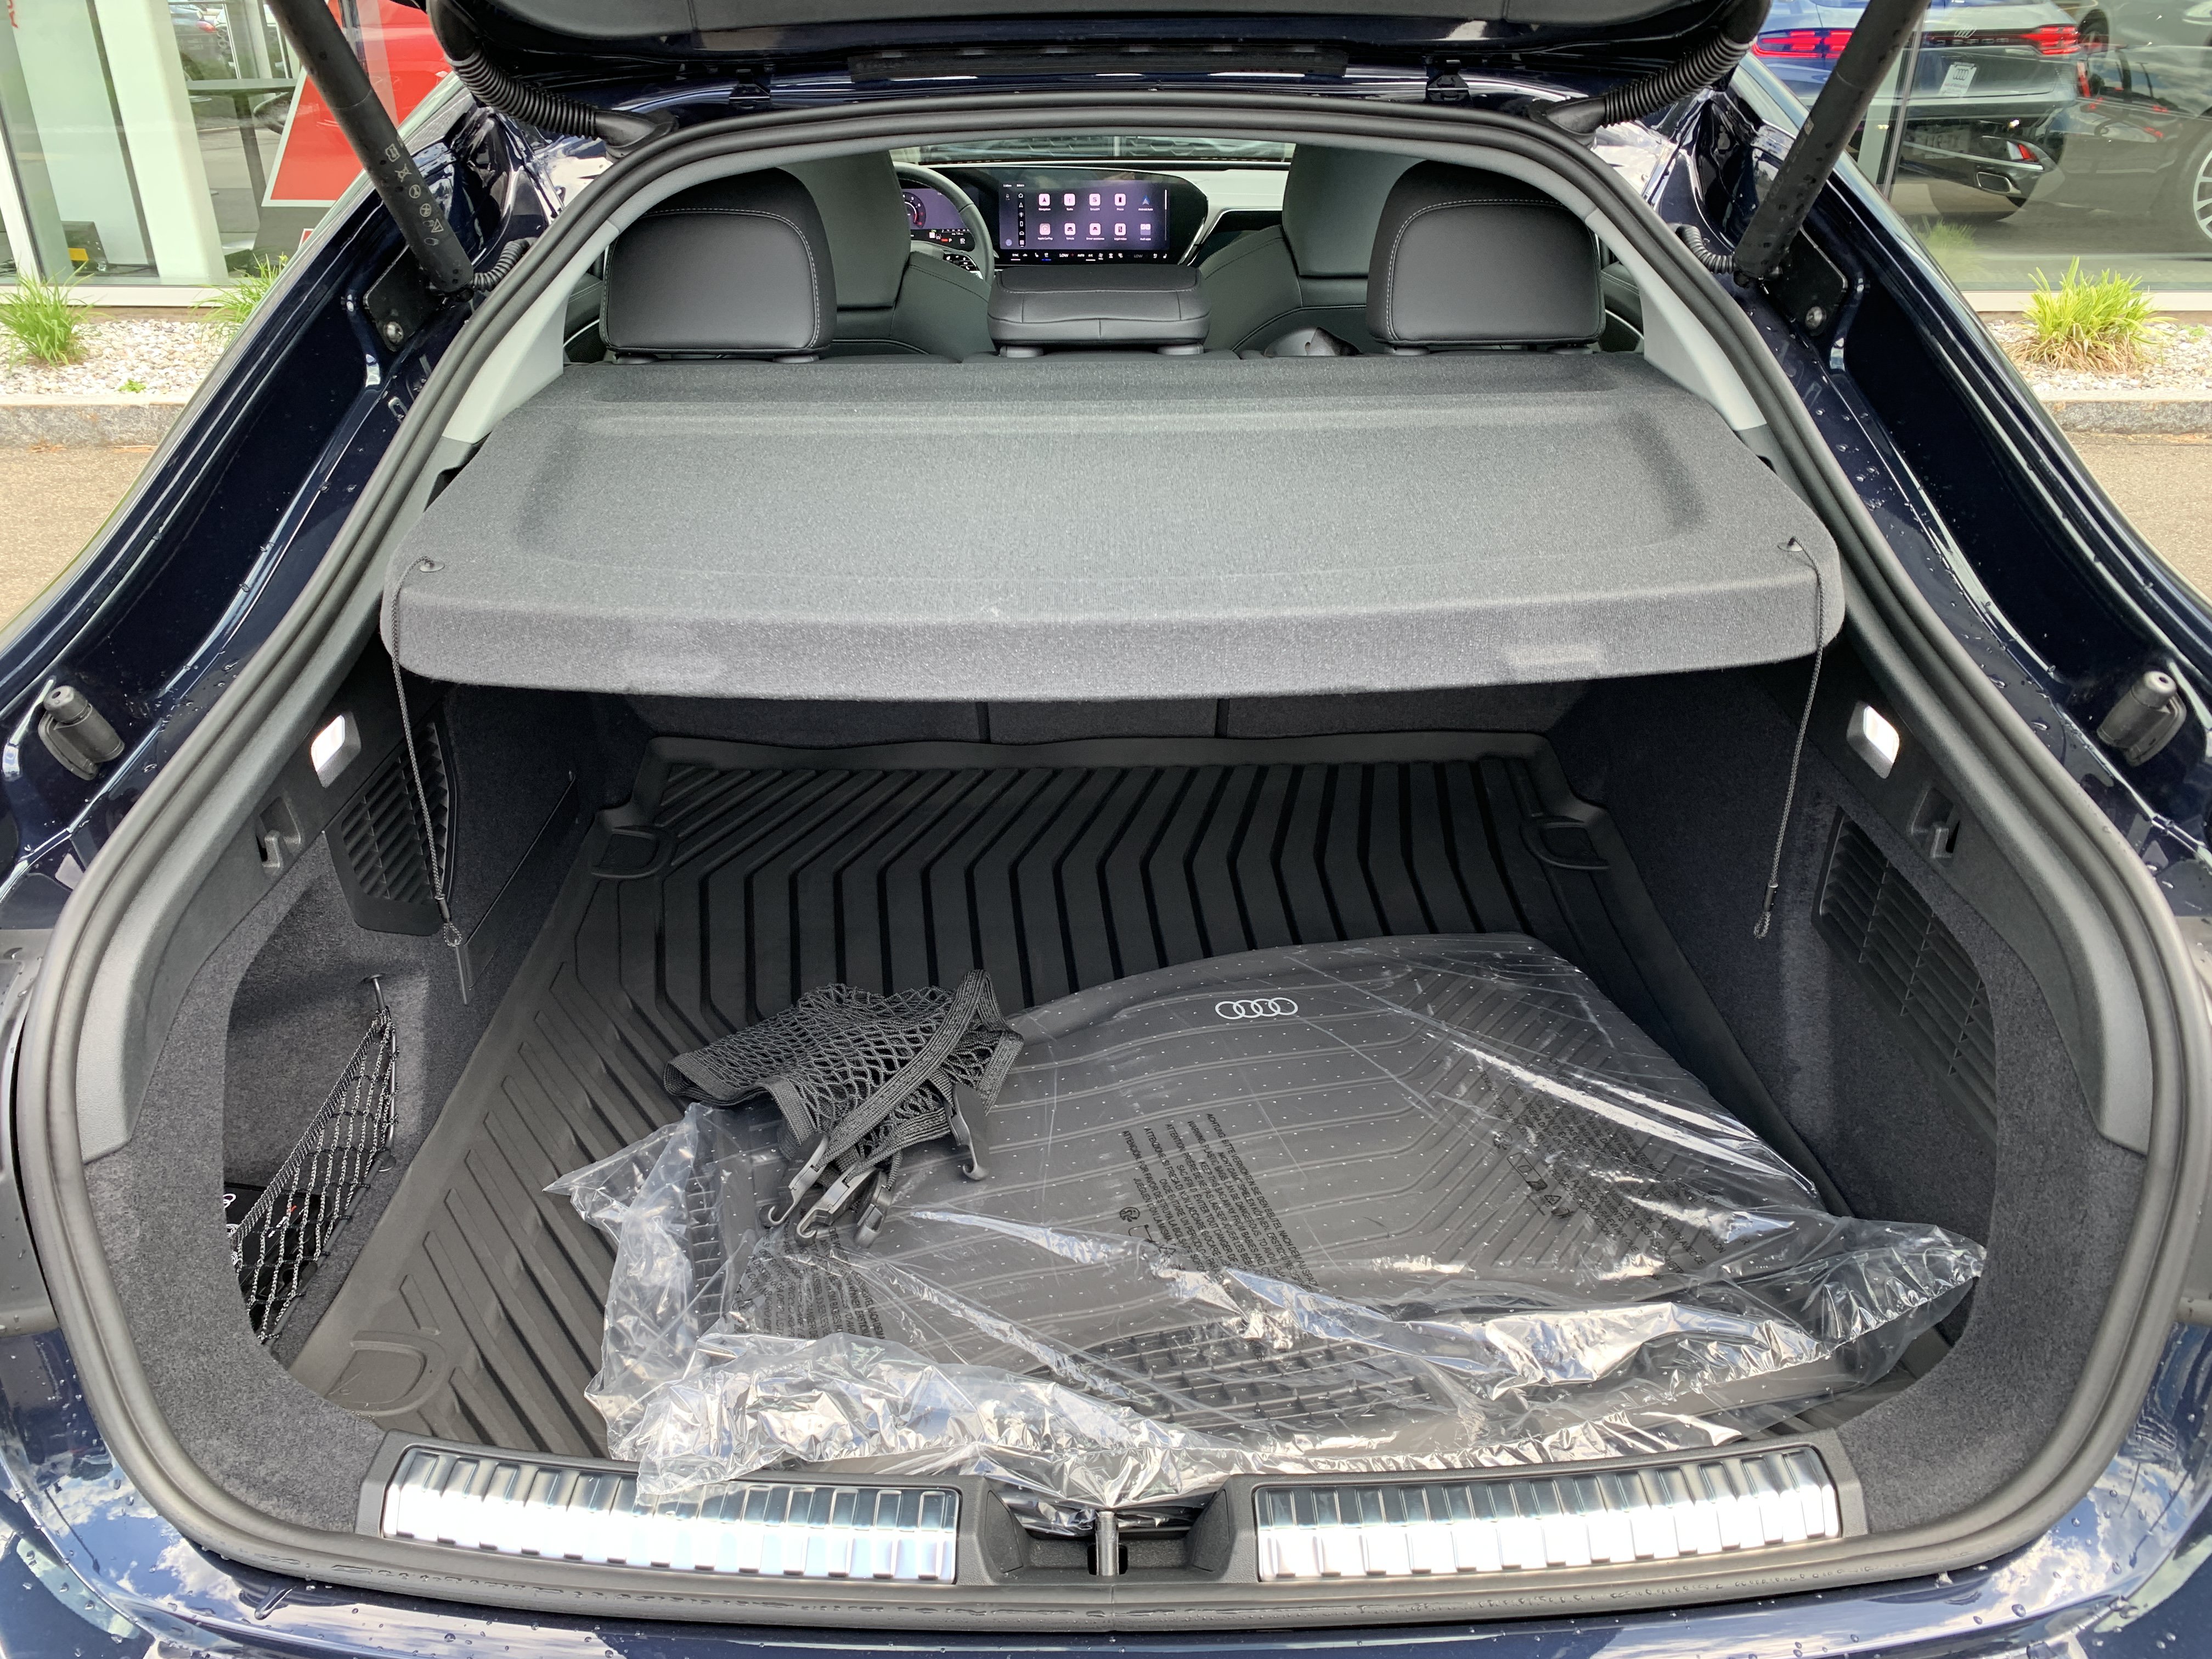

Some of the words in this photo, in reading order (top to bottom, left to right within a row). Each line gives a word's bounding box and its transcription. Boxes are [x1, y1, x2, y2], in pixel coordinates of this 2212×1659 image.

[1200, 1144, 1220, 1165] PLASTIC
[1163, 1166, 1182, 1184] PREGA
[1175, 1165, 1189, 1176] SAC
[1198, 1161, 1214, 1176] KEEP
[1213, 1165, 1229, 1181] BAGS
[1141, 1172, 1161, 1192] FAVOR
[1157, 1178, 1175, 1194] ONDE
[1182, 1176, 1195, 1188] AFIN
[1197, 1180, 1208, 1188] NE
[1206, 1175, 1221, 1187] THIS
[1222, 1181, 1237, 1193] CAN
[1130, 1177, 1154, 1203] JUEGUEN
[1144, 1203, 1160, 1216] CON
[1177, 1190, 1192, 1203] NON
[1201, 1187, 1215, 1199] PAS
[1213, 1187, 1228, 1199] BAG
[1221, 1139, 1237, 1154] BITTE
[1230, 1154, 1256, 1186] VERNICHTEN
[1250, 1186, 1262, 1195] SIE
[1256, 1195, 1270, 1208] DEN
[1263, 1208, 1284, 1229] BEUTEL
[1277, 1230, 1294, 1246] NACH
[1287, 1246, 1302, 1260] DEM
[1229, 1193, 1240, 1201] BE
[1236, 1183, 1257, 1206] SPIELEN
[1150, 1191, 1177, 1220] DESTRUYA
[1165, 1194, 1188, 1217] EVITARE
[1207, 1199, 1228, 1221] LAISSER
[1220, 1199, 1237, 1215] AWAY
[1167, 1219, 1179, 1227] LA
[1178, 1216, 1191, 1226] UN
[1183, 1203, 1208, 1230] LASCIARE
[1203, 1212, 1220, 1229] TOUT
[1229, 1215, 1247, 1232] FROM
[1170, 1227, 1190, 1246] BOLSA
[1220, 1221, 1240, 1241] JOUER
[1198, 1230, 1223, 1256] GIOCARE
[1211, 1229, 1235, 1254] DANGER
[1232, 1241, 1246, 1252] LES
[1239, 1231, 1260, 1252] BABIES
[1256, 1238, 1268, 1246] TO
[1623, 1237, 1640, 1253] QUE
[1252, 1252, 1267, 1266] AND
[1261, 1246, 1280, 1265] AVOID
